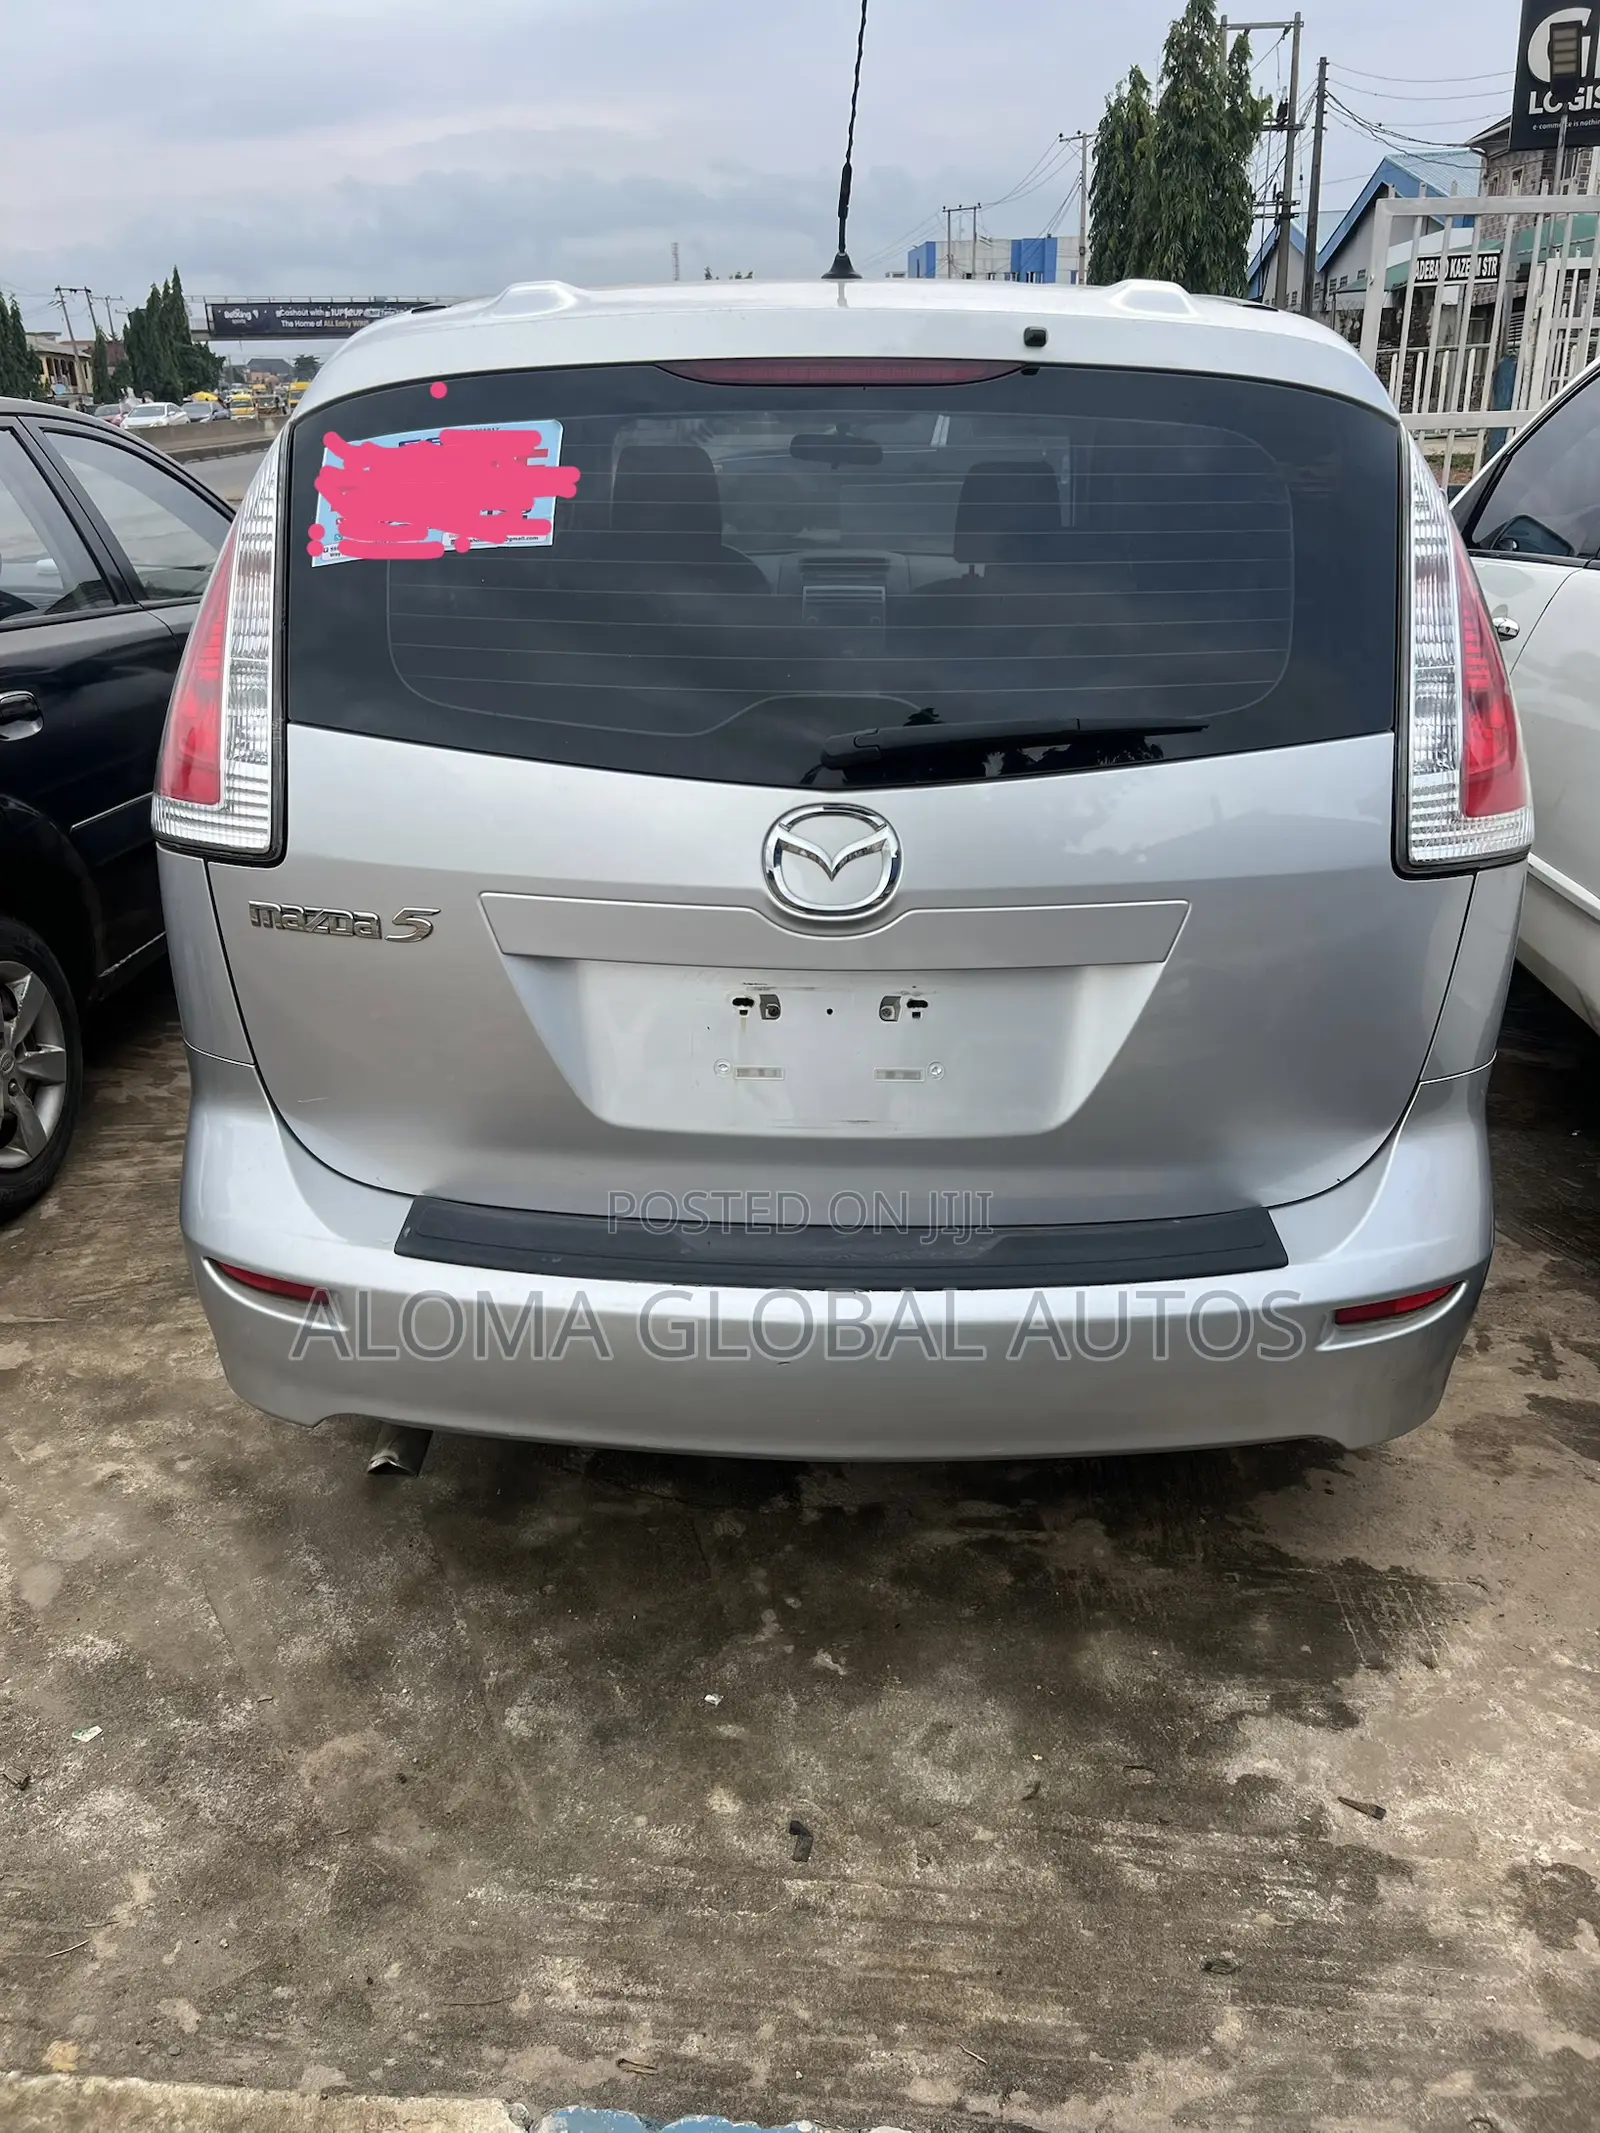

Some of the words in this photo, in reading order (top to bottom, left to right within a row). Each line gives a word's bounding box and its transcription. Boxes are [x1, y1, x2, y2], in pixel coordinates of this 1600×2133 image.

[1482, 256, 1498, 277] STR
[281, 320, 294, 328] The
[294, 319, 315, 328] Home
[316, 319, 323, 327] of
[384, 907, 441, 942] 5
